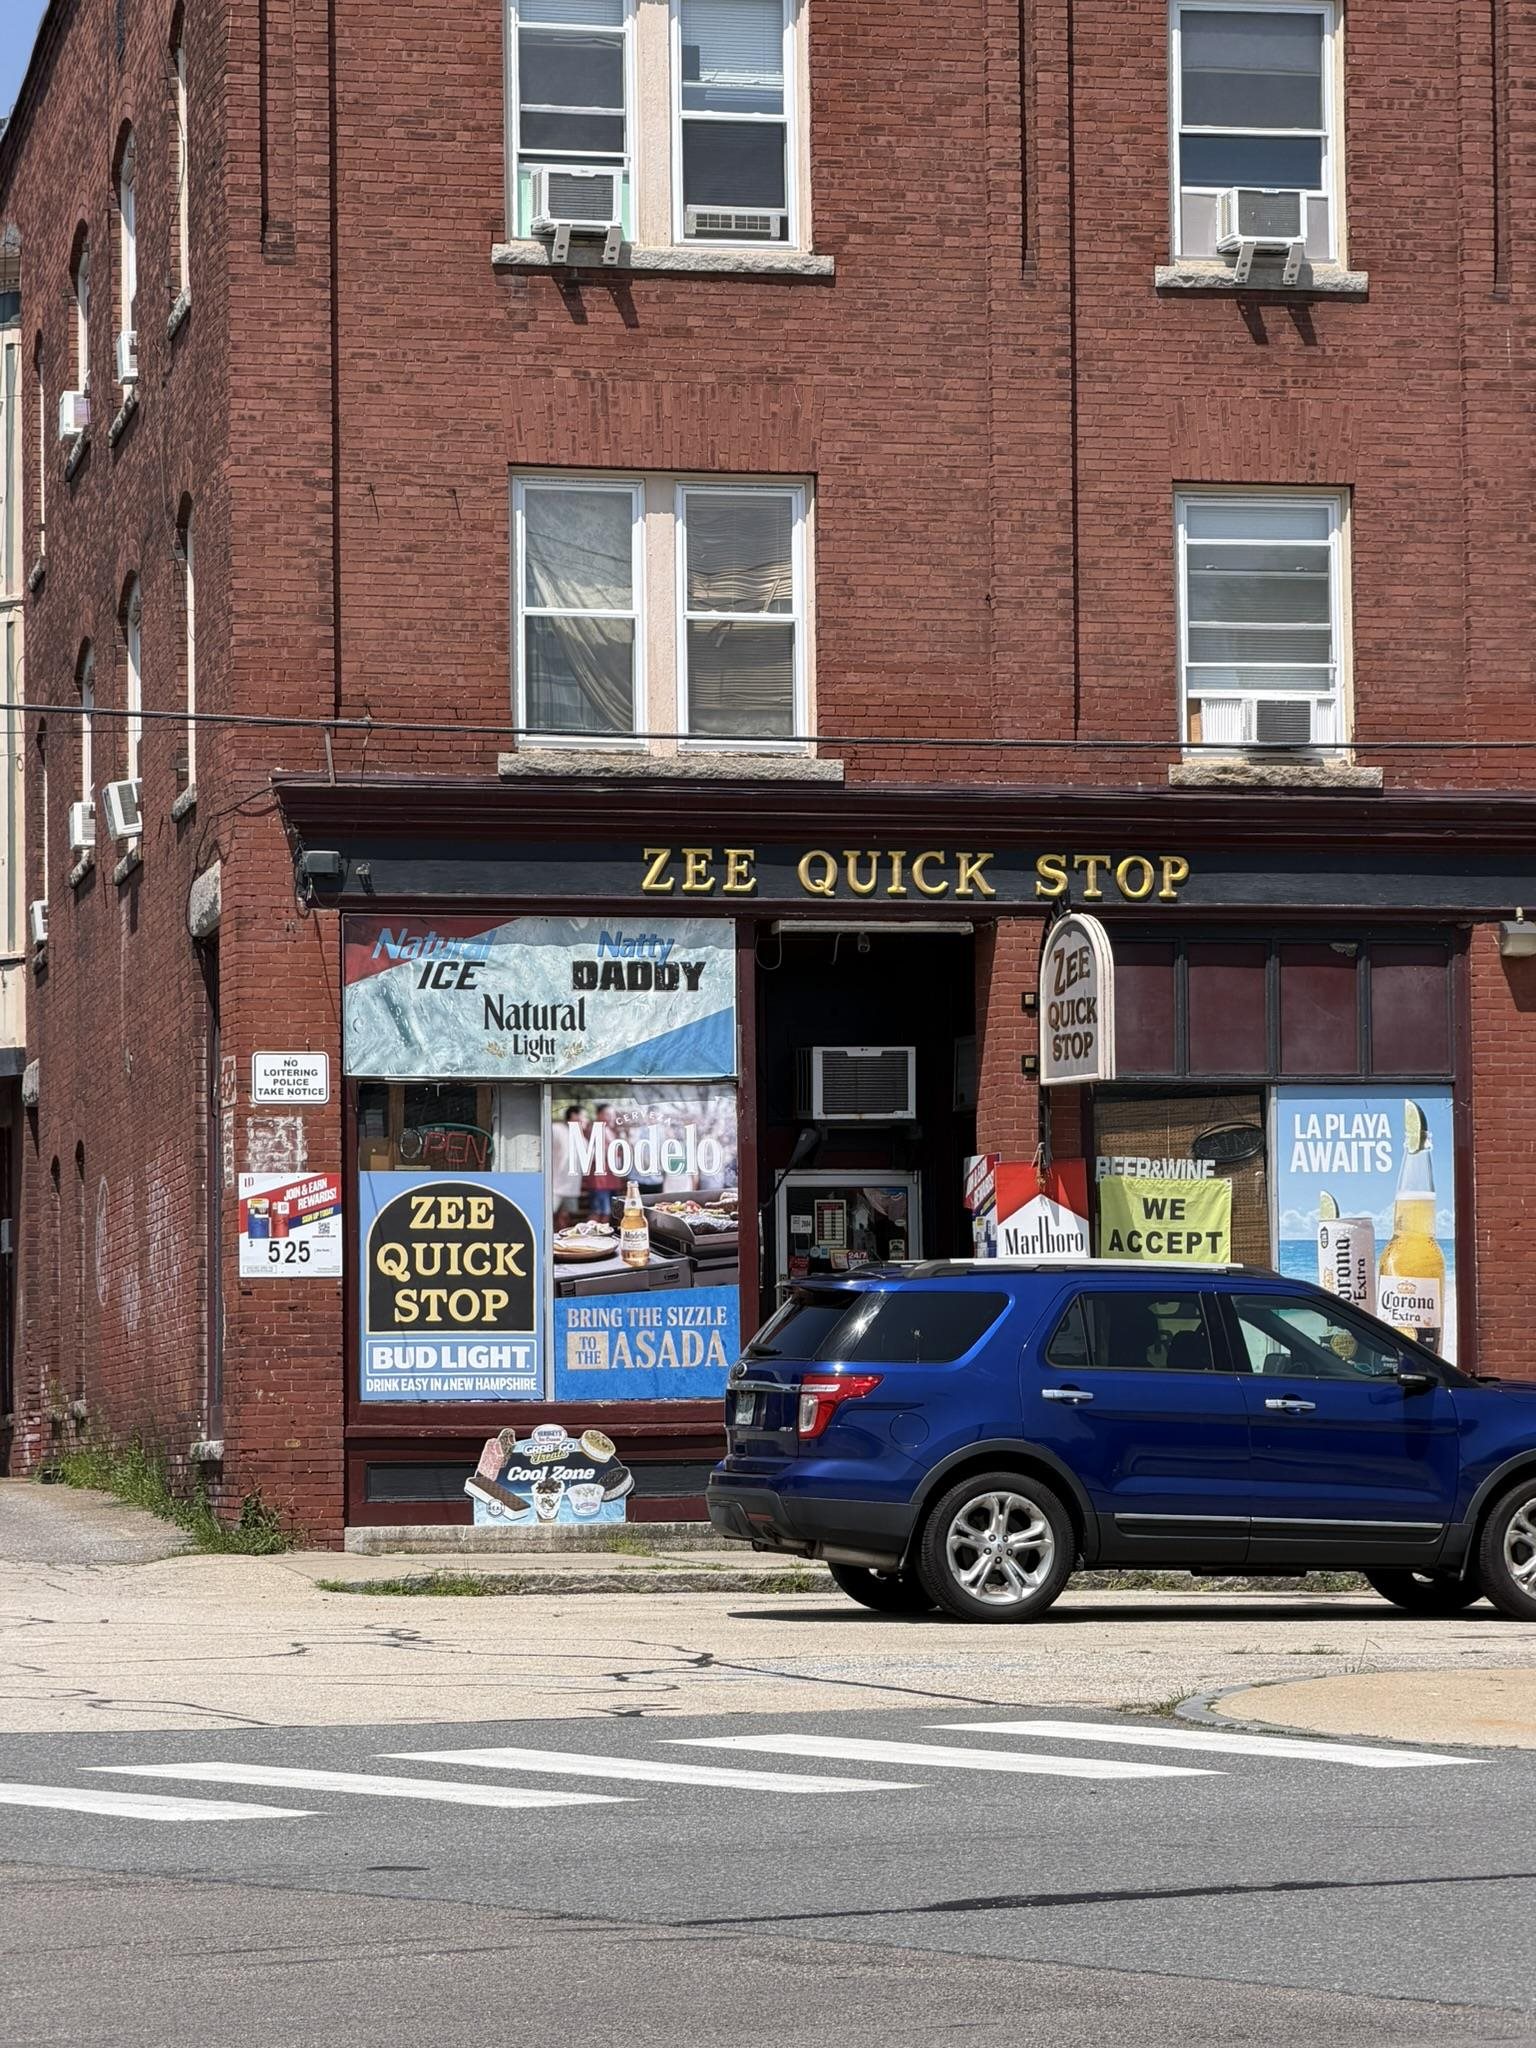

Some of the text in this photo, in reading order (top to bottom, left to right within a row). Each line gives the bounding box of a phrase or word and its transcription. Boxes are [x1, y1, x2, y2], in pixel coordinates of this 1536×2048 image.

[642, 848, 1190, 898] ZEE QUICK STOP
[372, 928, 498, 960] Natural
[597, 930, 675, 965] Natty
[417, 961, 486, 990] ICE
[572, 961, 706, 991] DADDY
[1053, 946, 1091, 996] ZEE
[483, 993, 586, 1032] Natural
[1048, 996, 1098, 1032] QUICK
[513, 1033, 557, 1063] Light
[1052, 1031, 1094, 1063] STOP
[263, 1069, 319, 1077] LOITERING
[283, 1059, 299, 1067] NO
[258, 1087, 325, 1096] TAKE NOTICE
[273, 1078, 310, 1086] POLICE
[615, 1110, 672, 1126] CERVEZA
[1294, 1113, 1392, 1139] LA PLAYA
[400, 1128, 488, 1165] OPEN
[567, 1121, 723, 1177] Modelo
[1290, 1140, 1393, 1173] AWAITS
[284, 1177, 328, 1201] JOIN & EARN
[297, 1187, 338, 1210] REWARDS!
[409, 1196, 495, 1230] ZEE
[1142, 1197, 1186, 1220] WE
[1005, 1215, 1084, 1255] Marlboro
[1108, 1229, 1223, 1255] ACCEPT
[376, 1242, 527, 1282] QUICK
[1336, 1238, 1352, 1301] orona
[1354, 1257, 1367, 1300] Extra
[394, 1288, 509, 1323] STOP
[1381, 1290, 1434, 1310] Corona
[567, 1305, 727, 1328] BRING THE SIZZLE
[1389, 1309, 1421, 1322] Extra
[579, 1336, 597, 1350] TO
[611, 1330, 729, 1369] ASADA
[372, 1346, 438, 1370] BUD
[576, 1351, 601, 1365] THE
[366, 1377, 537, 1392] DRINK EASY IN NEW HAMPSHIRE
[507, 1466, 595, 1481] Cool Zone
